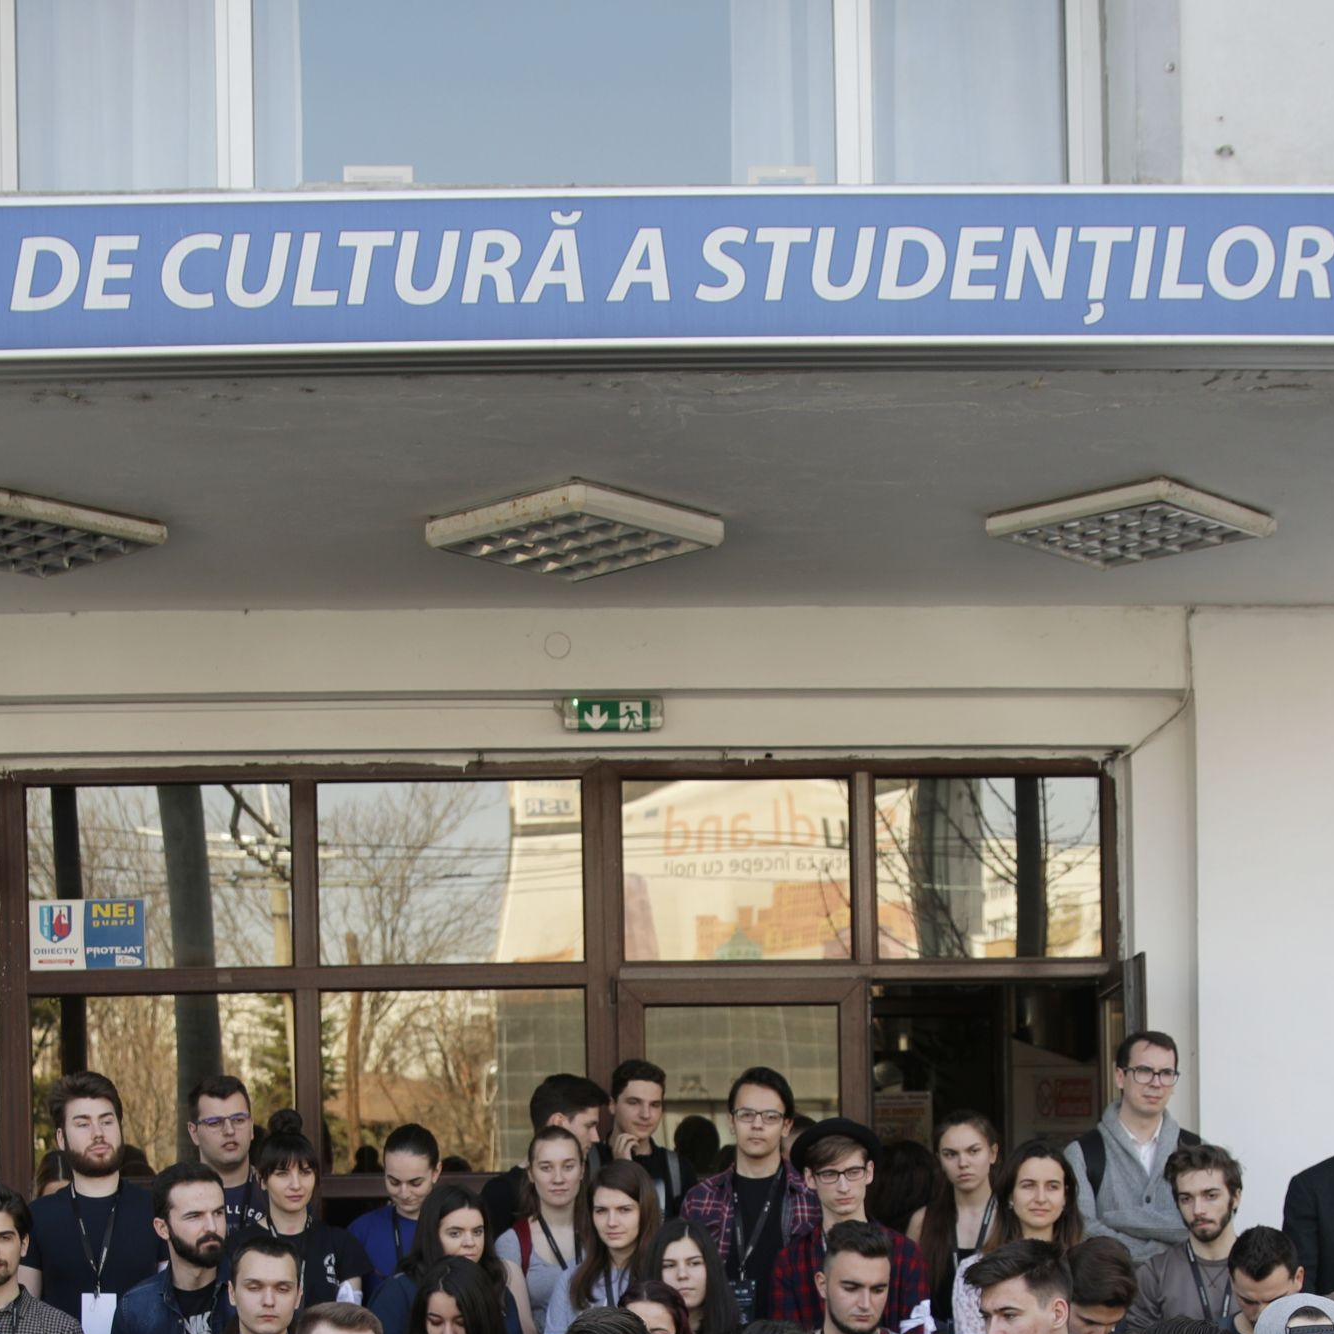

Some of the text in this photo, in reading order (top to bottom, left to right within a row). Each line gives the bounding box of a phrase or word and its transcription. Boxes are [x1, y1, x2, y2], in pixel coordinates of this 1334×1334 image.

[9, 235, 140, 313] DE
[161, 209, 586, 308] CULTURĂ
[605, 229, 671, 303] A
[92, 919, 134, 927] guard
[33, 947, 79, 955] OBIECTIV
[86, 946, 142, 957] PROTEJAT
